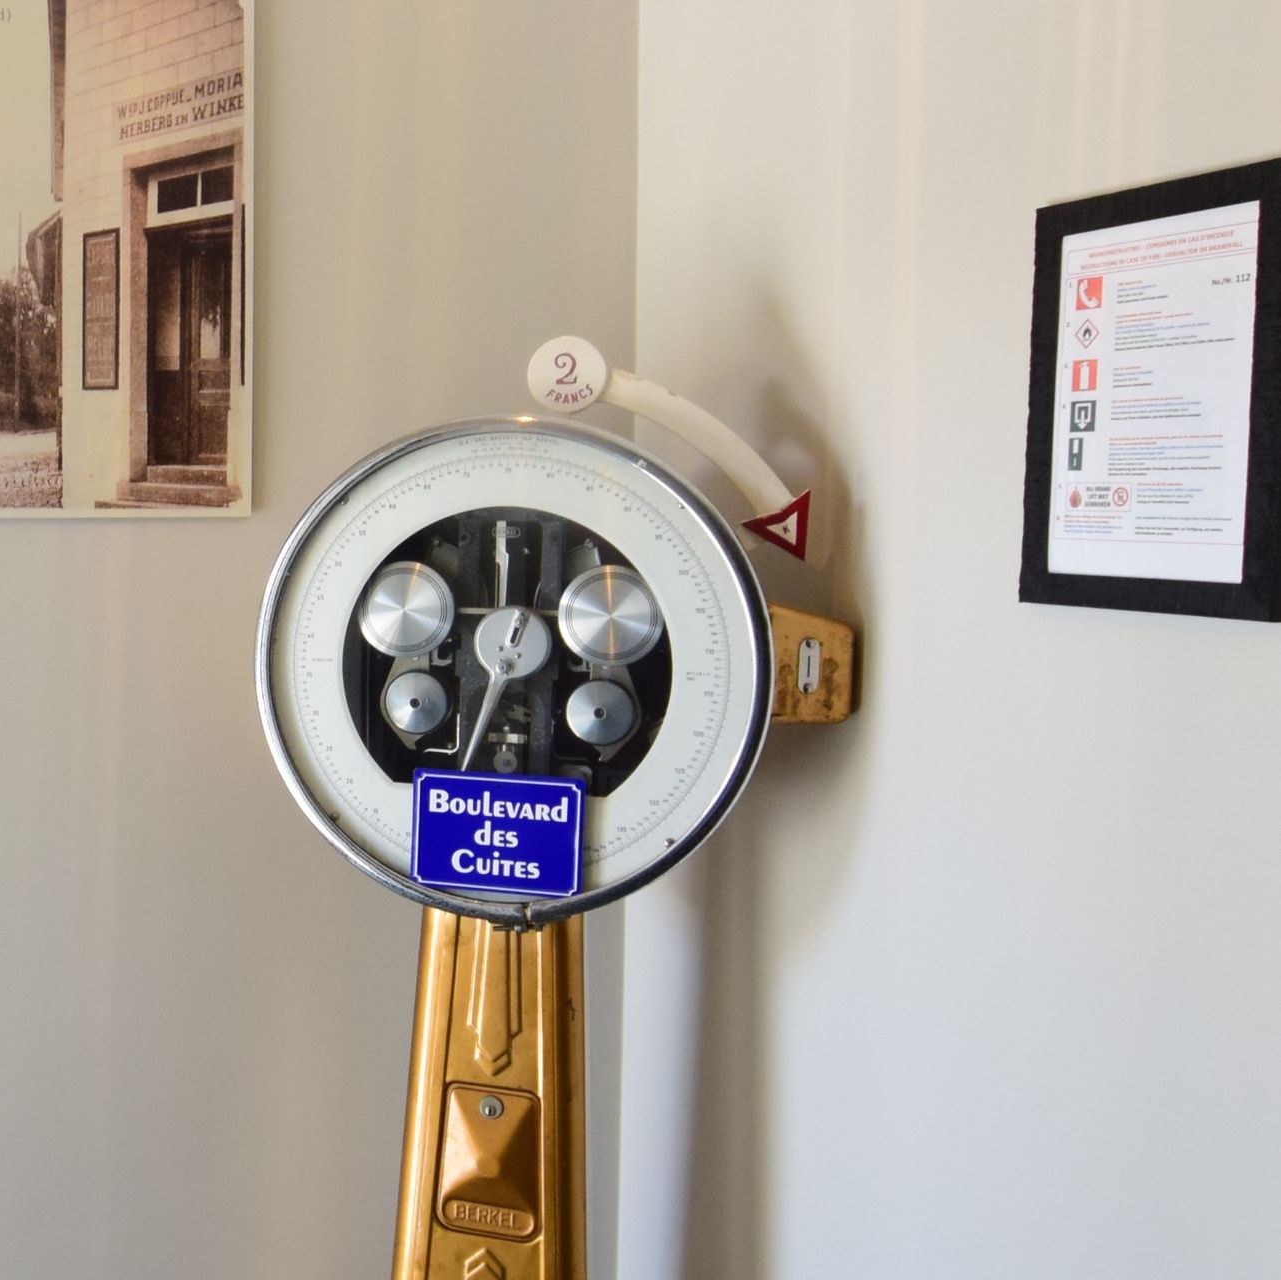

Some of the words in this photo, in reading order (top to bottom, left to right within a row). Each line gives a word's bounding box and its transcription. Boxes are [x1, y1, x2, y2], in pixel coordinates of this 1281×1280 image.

[119, 113, 173, 140] HERBERG
[1236, 272, 1251, 284] 112
[554, 352, 578, 385] 2
[546, 383, 593, 405] FRANCS
[453, 1202, 521, 1229] BERKEL
